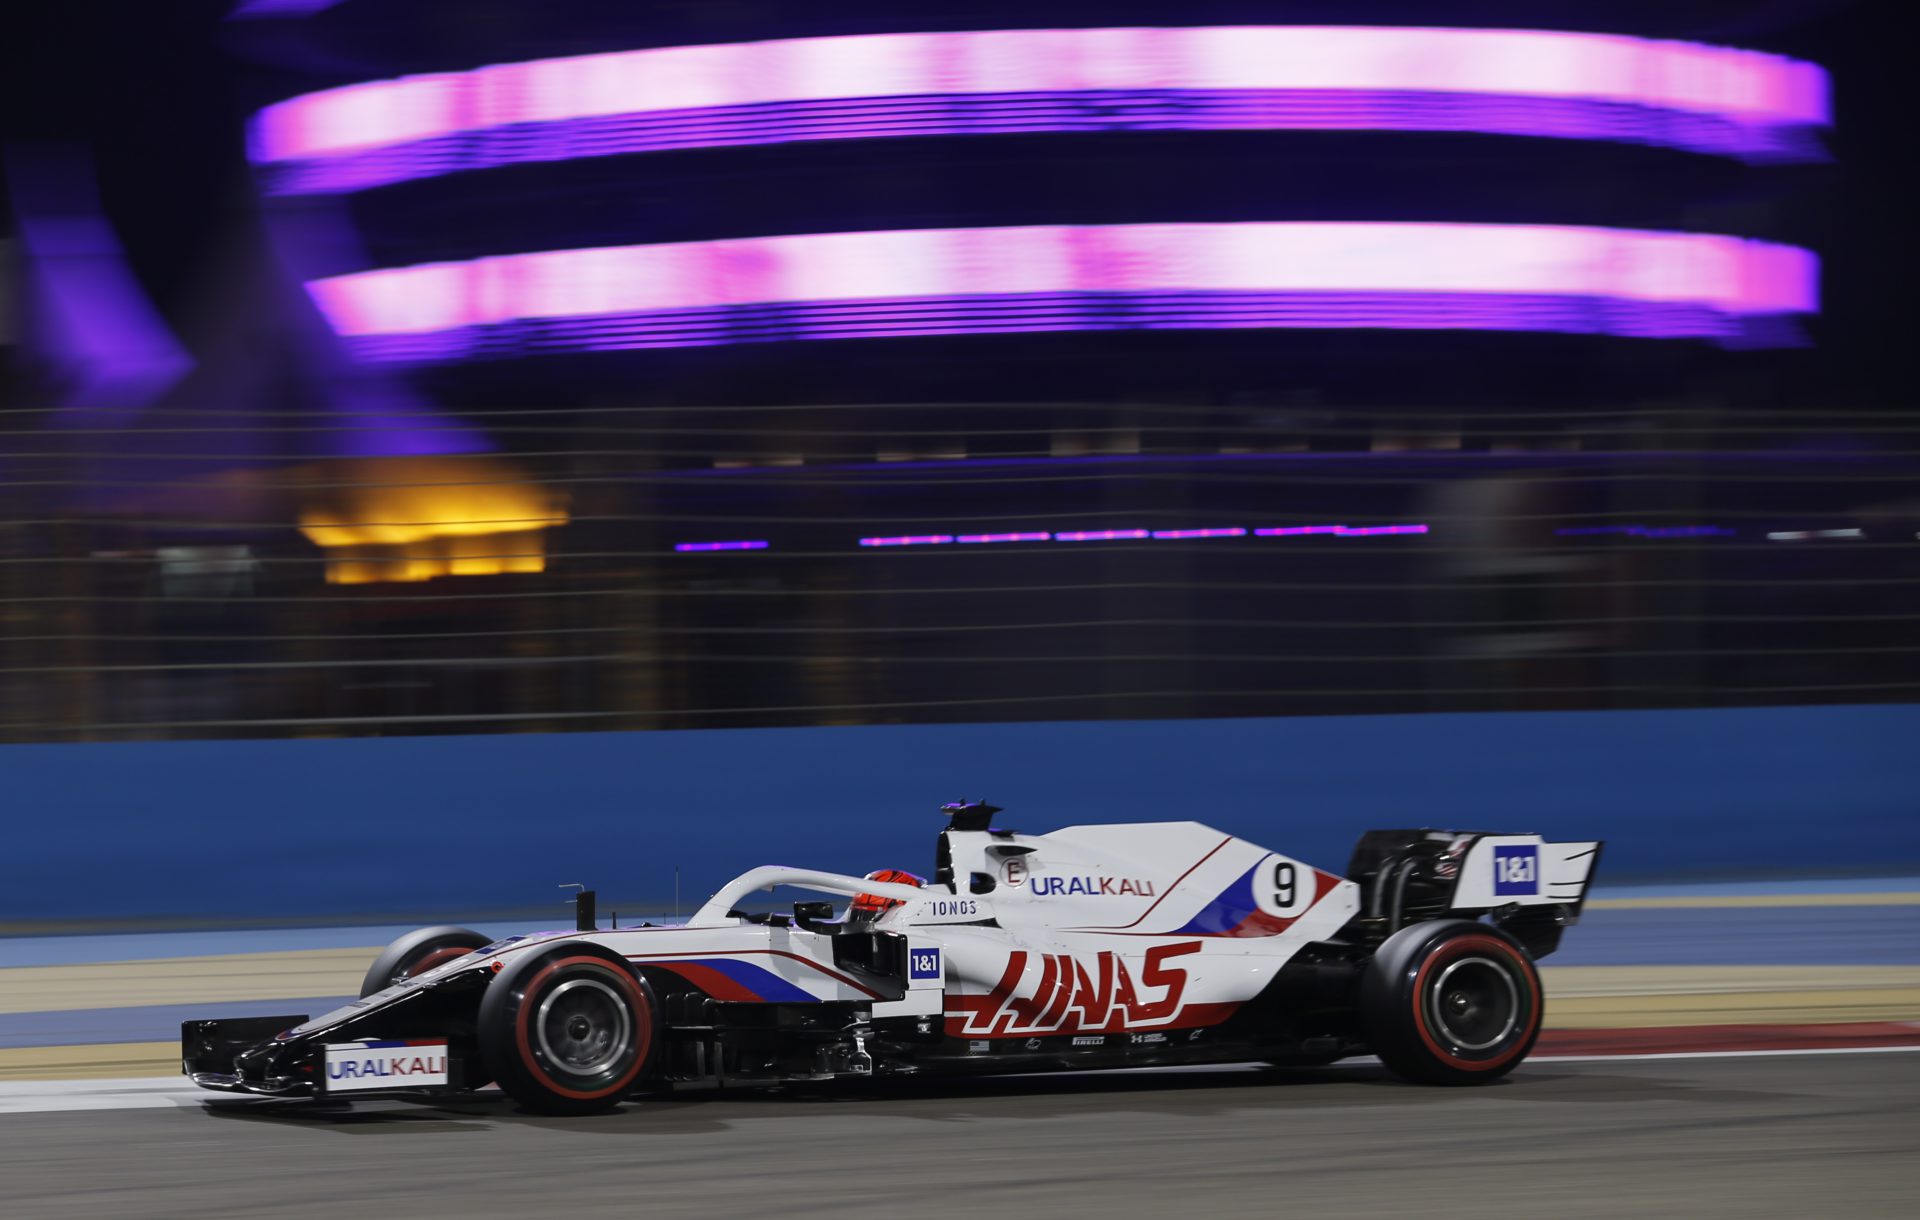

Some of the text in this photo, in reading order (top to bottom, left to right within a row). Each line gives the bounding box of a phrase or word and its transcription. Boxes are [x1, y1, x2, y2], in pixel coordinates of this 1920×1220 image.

[1007, 862, 1021, 884] E
[1495, 856, 1536, 883] 1&1
[1031, 877, 1155, 897] URALKALI
[1274, 861, 1297, 908] 9
[932, 900, 977, 916] IONOS
[912, 954, 937, 972] 1&1
[962, 940, 1203, 1034] HAAS
[1072, 1036, 1105, 1046] PIRELLI
[326, 1056, 447, 1080] URALKALI
